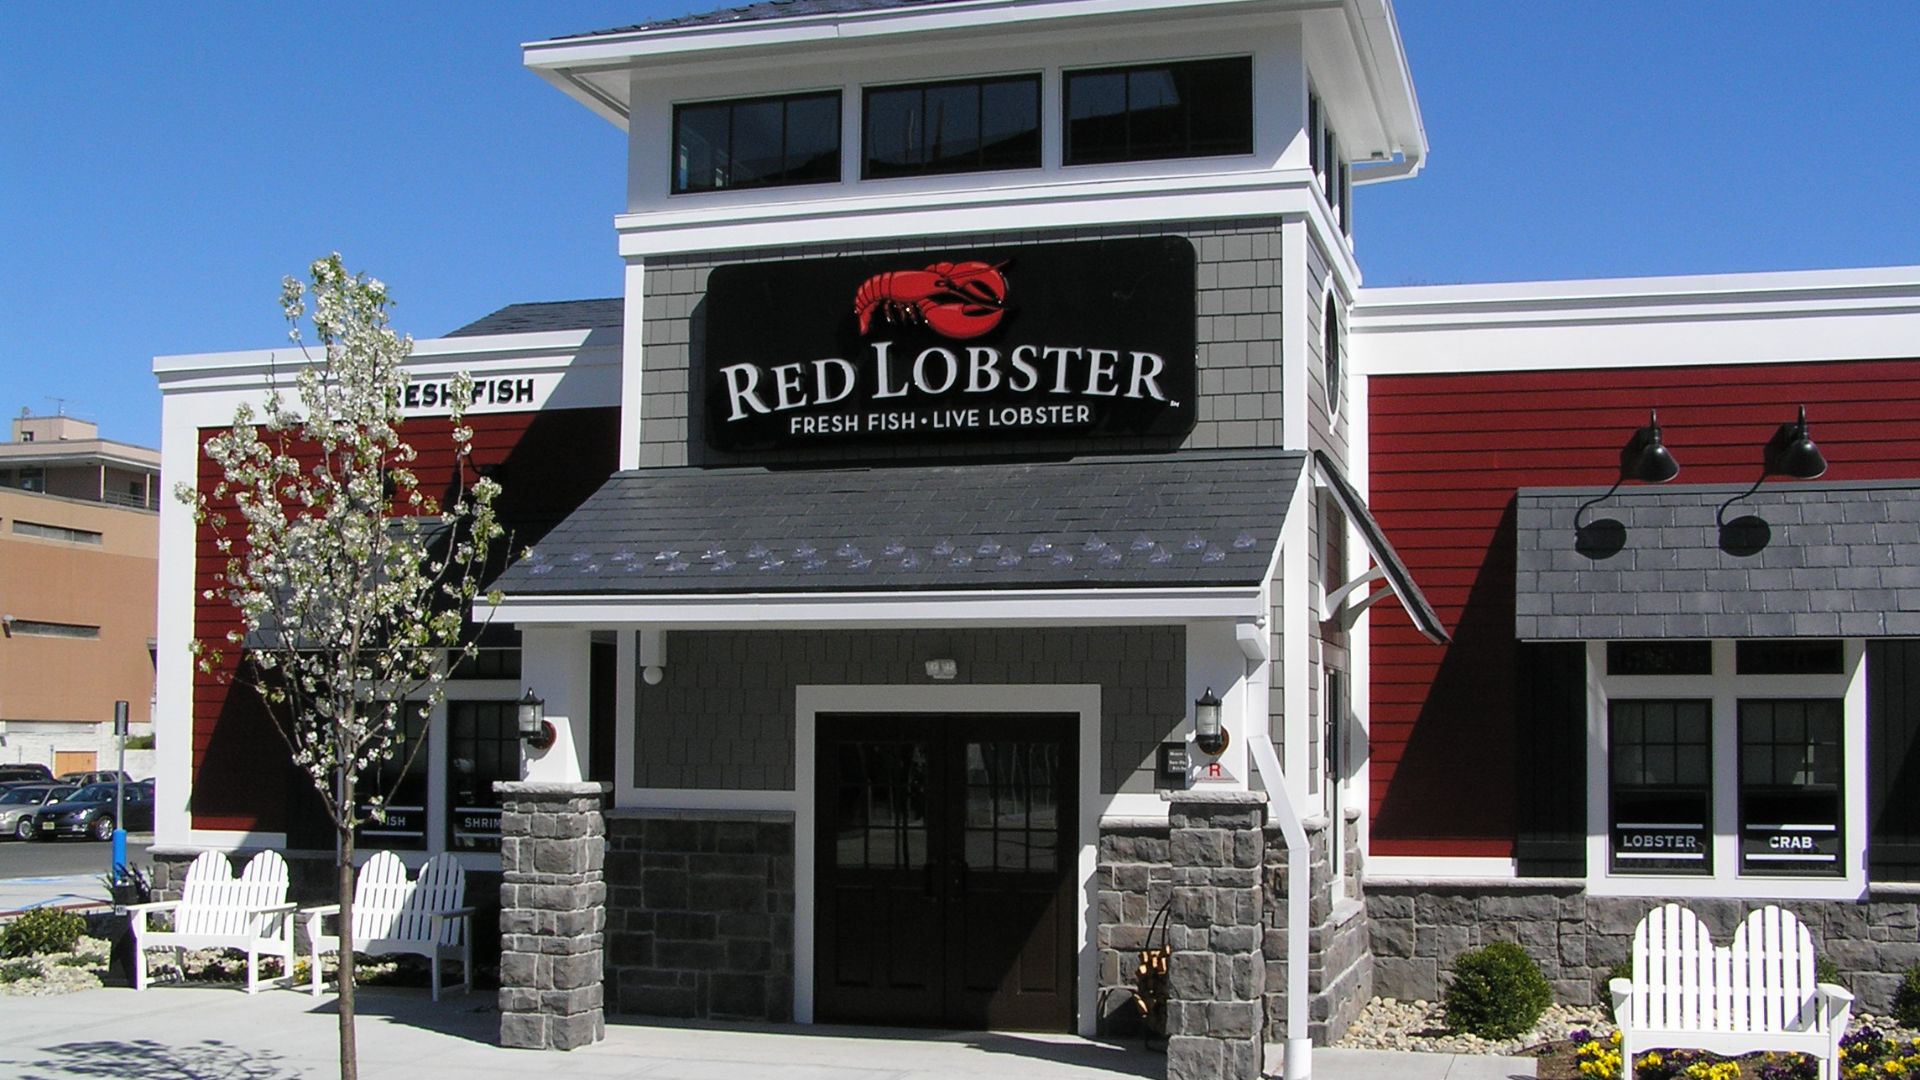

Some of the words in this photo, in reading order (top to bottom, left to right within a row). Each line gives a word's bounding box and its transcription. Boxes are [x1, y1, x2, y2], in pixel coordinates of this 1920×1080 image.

[720, 358, 855, 422] RED
[871, 341, 1166, 401] LOBSTER
[384, 383, 456, 408] ESH
[470, 379, 534, 404] FISH
[791, 415, 858, 434] FRESH
[868, 412, 915, 431] FISH
[933, 409, 979, 428] LIVE
[989, 405, 1089, 426] LOBSTER
[464, 817, 501, 828] SHRIM
[1623, 835, 1696, 848] LOBSTER
[1769, 836, 1813, 849] CRAB
